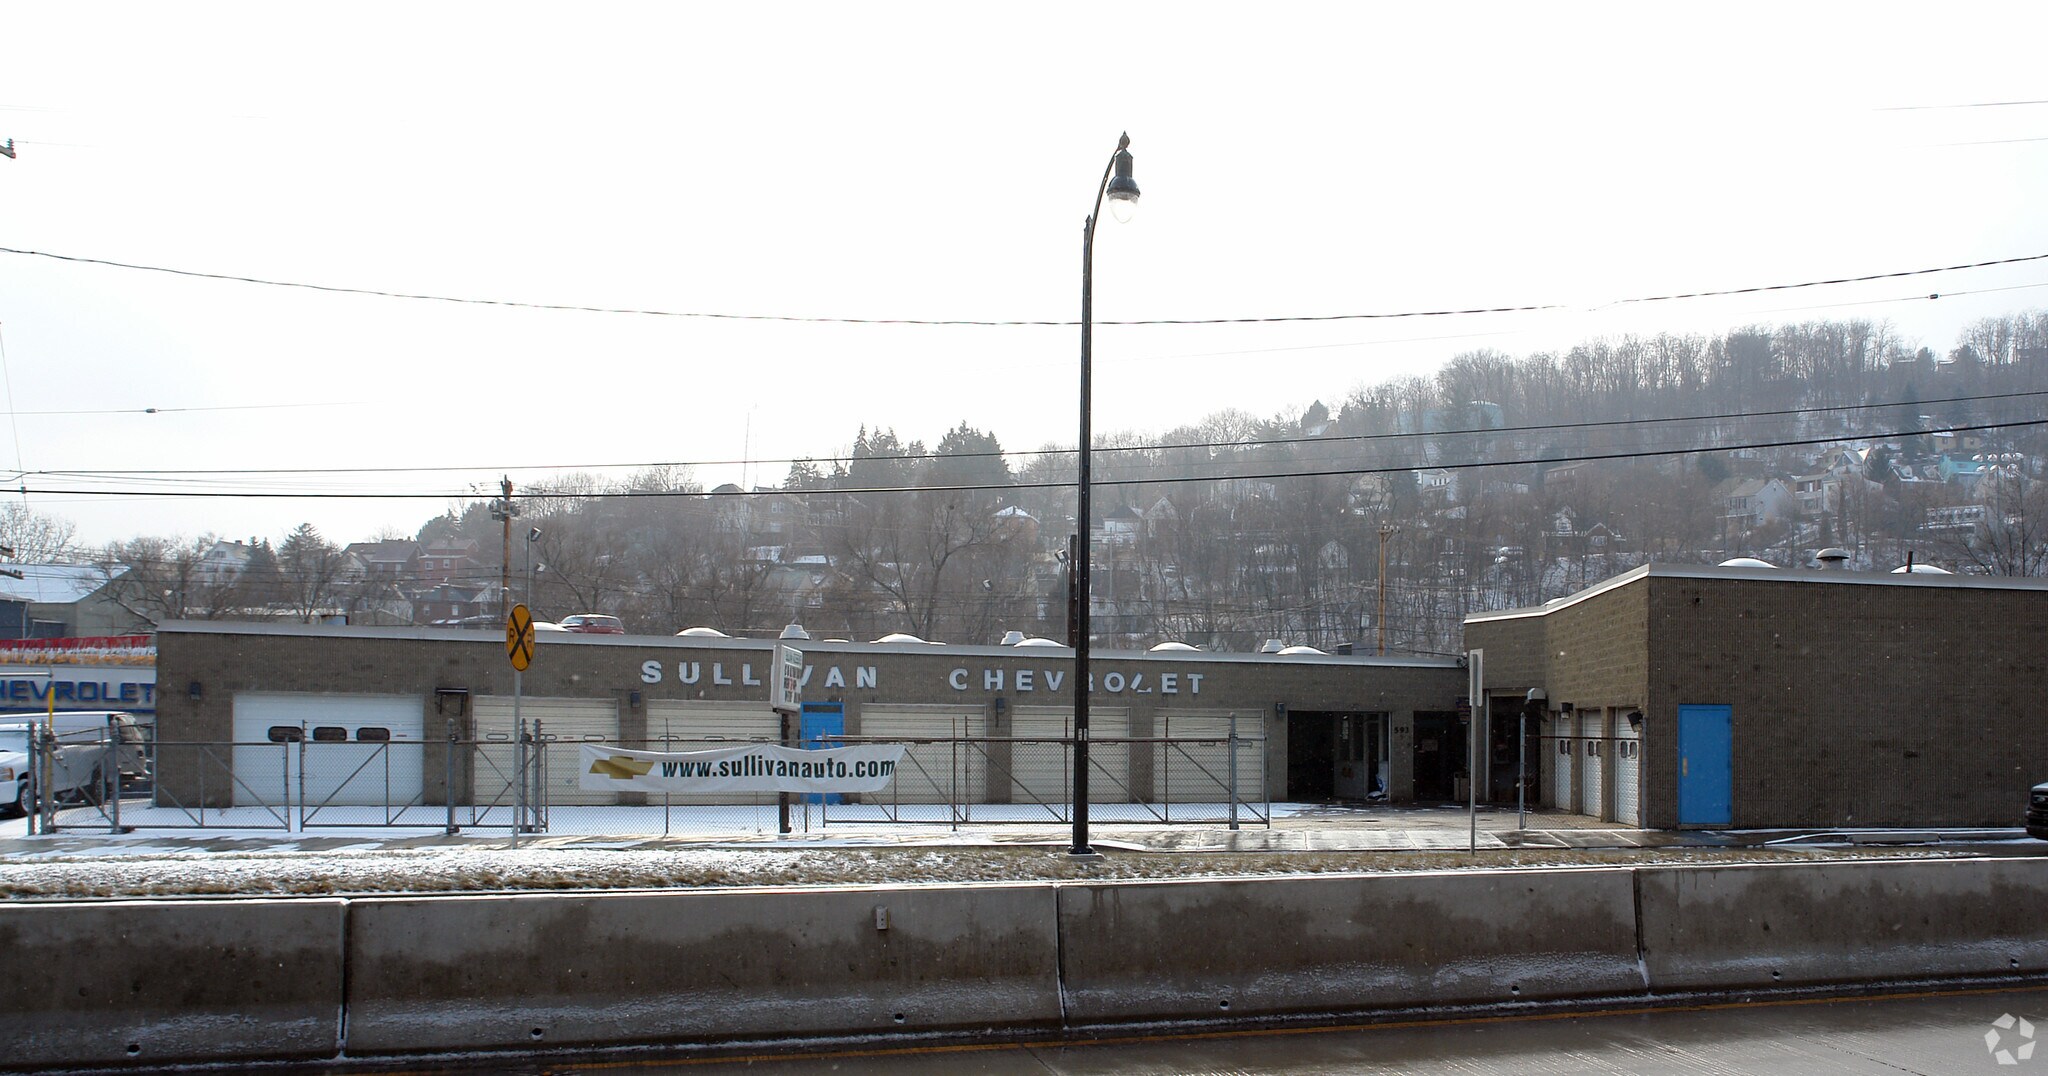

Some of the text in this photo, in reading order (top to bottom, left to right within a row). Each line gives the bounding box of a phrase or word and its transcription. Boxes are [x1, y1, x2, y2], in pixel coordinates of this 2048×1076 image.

[641, 660, 877, 688] SULLVAN
[949, 668, 1204, 694] CHEVOLET
[661, 755, 896, 778] www.sullivanauto.com
